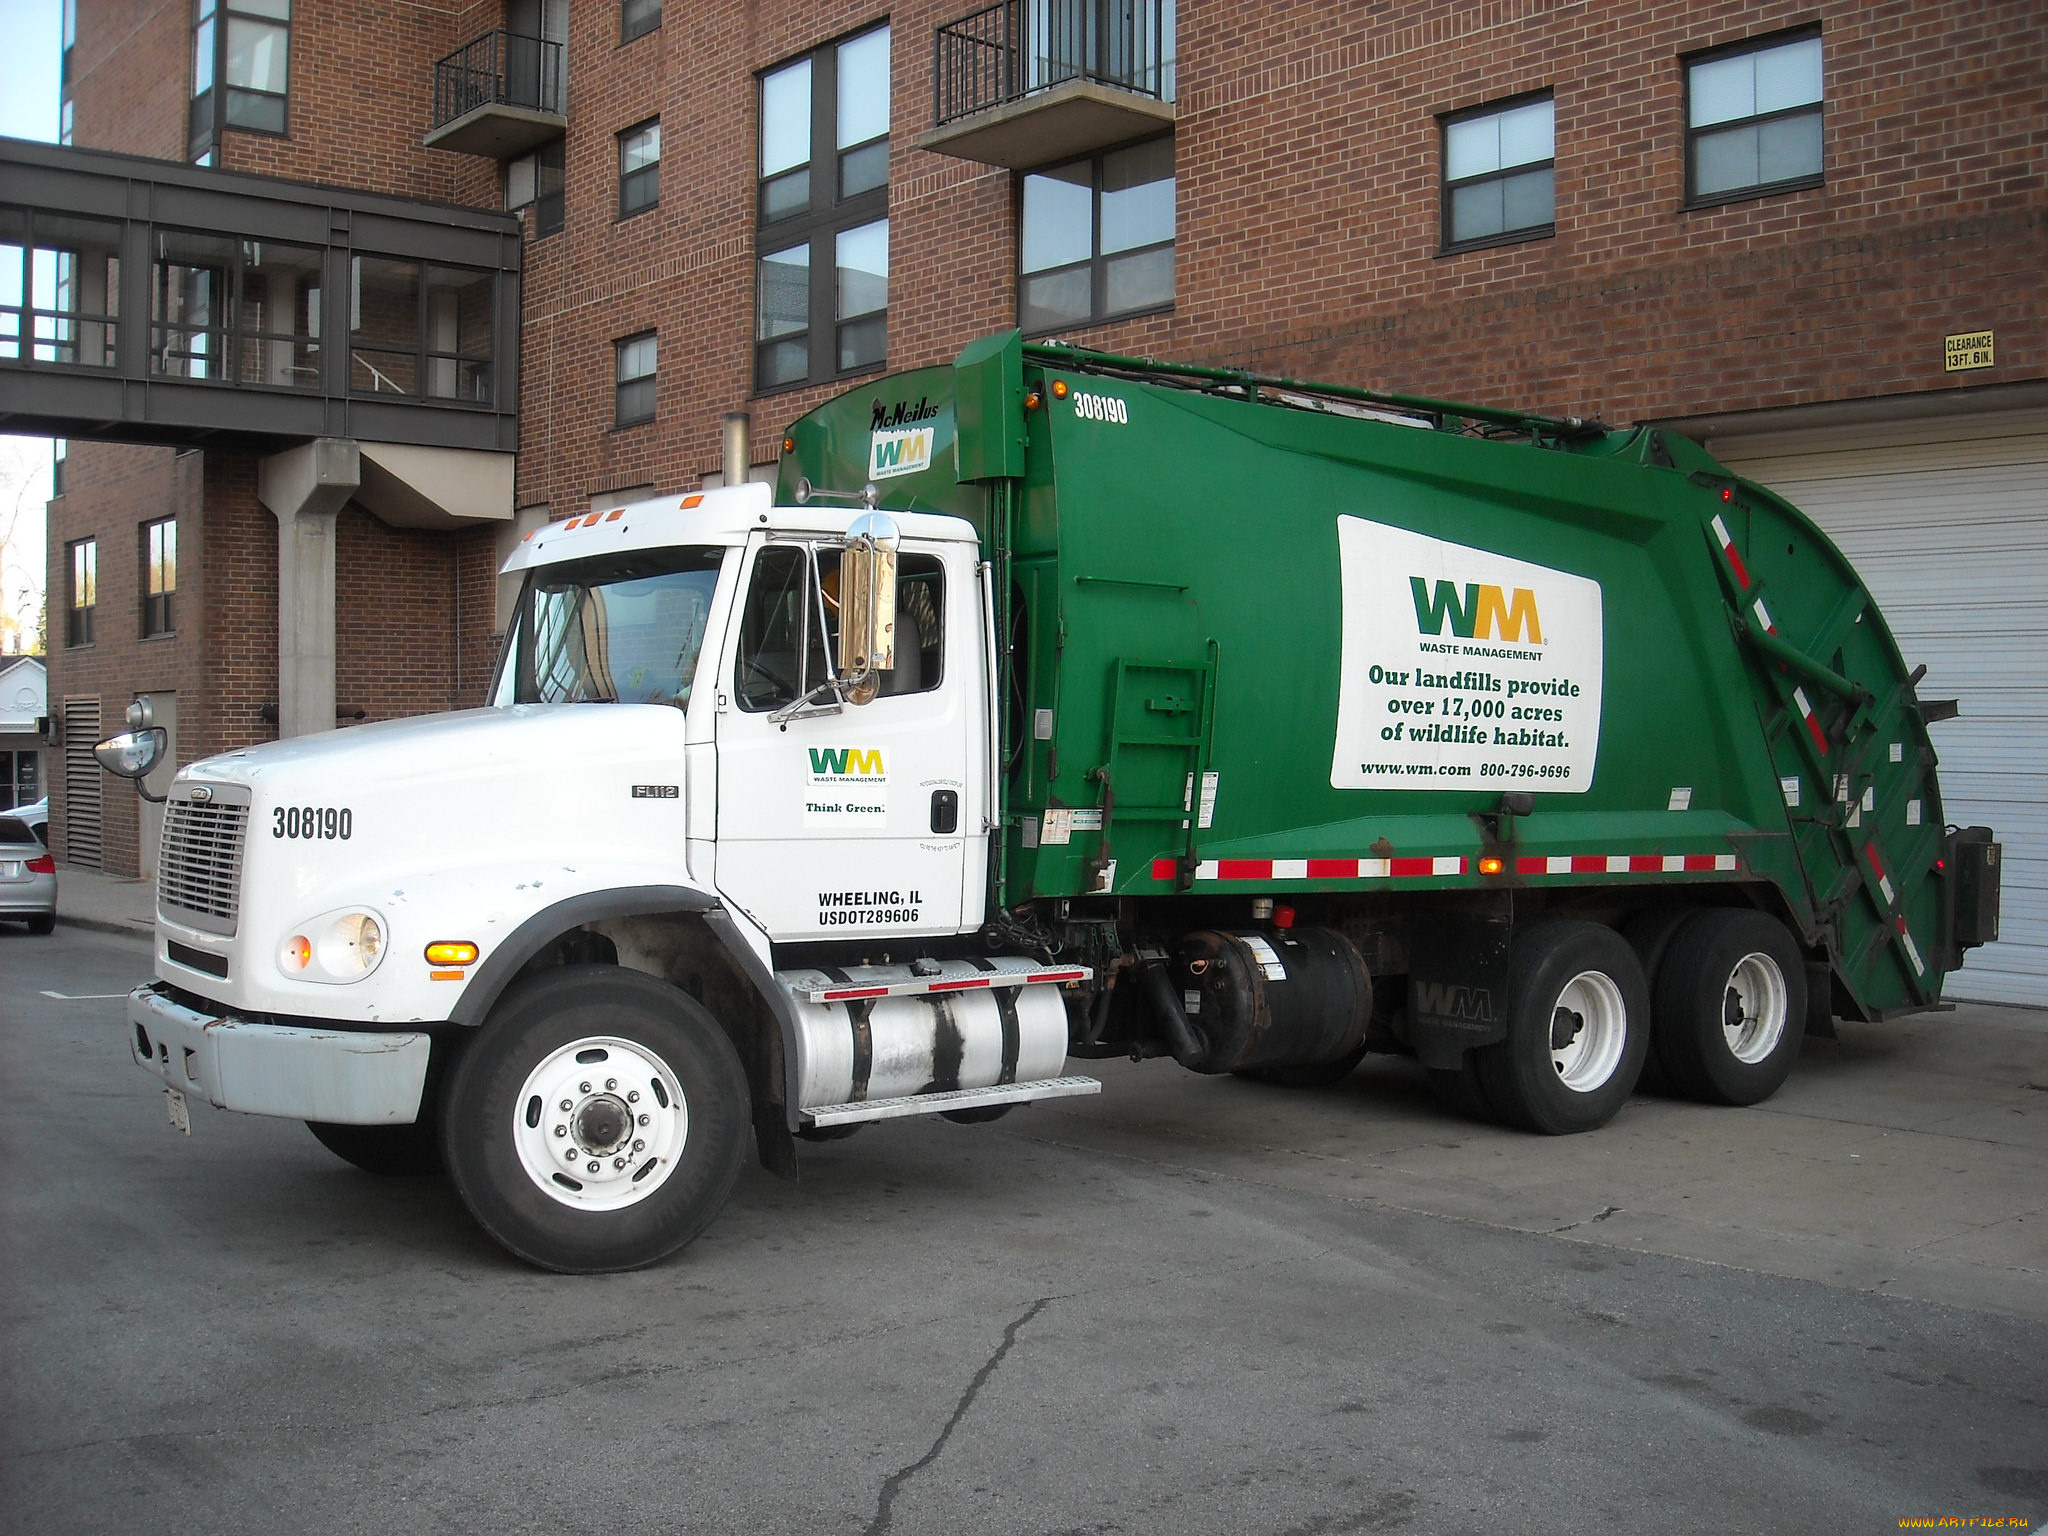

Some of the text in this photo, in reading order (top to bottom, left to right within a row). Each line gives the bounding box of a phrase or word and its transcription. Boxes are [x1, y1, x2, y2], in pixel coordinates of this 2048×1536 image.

[1947, 335, 1992, 352] CLEARANCE
[1947, 351, 1992, 367] 13FT. 6IN.
[870, 396, 939, 431] McNeilus
[1073, 391, 1129, 425] 308190
[876, 434, 925, 470] WM
[1409, 576, 1543, 645] WM
[1419, 642, 1543, 662] WASTE MANAGEMENT
[1368, 664, 1581, 699] Our landfills provide
[1387, 697, 1563, 722] over 17,000 acres
[1380, 721, 1570, 748] of wildlife habitat.
[808, 748, 885, 775] WM
[1360, 763, 1571, 778] www.wm.com 800-796-9696
[635, 786, 676, 797] FL112
[805, 802, 842, 813] Think
[272, 806, 352, 841] 308190
[818, 890, 923, 907] WHEELING, IL
[819, 908, 919, 926] USDOT289606
[1415, 980, 1493, 1022] WM
